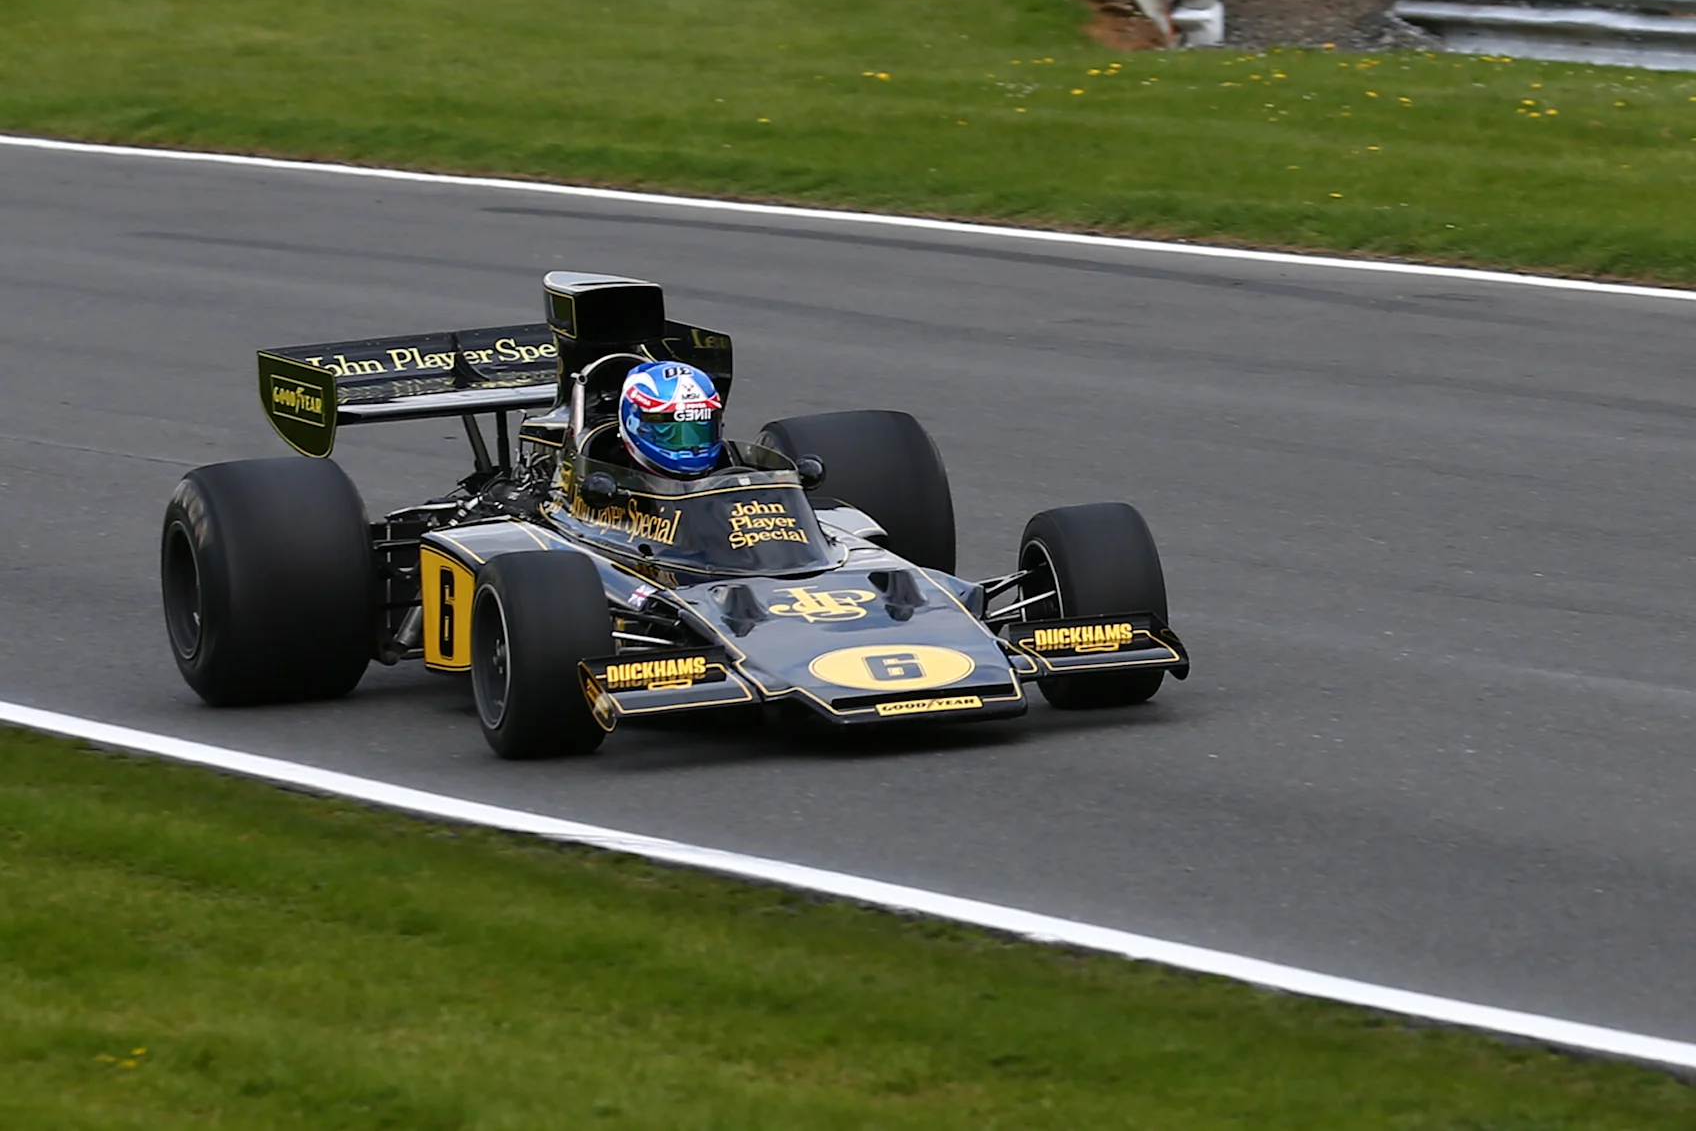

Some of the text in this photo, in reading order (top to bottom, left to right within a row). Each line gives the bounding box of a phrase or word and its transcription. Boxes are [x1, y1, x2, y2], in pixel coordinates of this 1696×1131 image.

[387, 346, 492, 372] Player
[673, 408, 712, 422] GENII
[731, 500, 787, 517] John
[627, 498, 682, 545] Special
[728, 516, 796, 532] Player
[728, 528, 810, 550] Special
[440, 567, 455, 659] 6
[1033, 622, 1134, 647] DUCKHAMS
[606, 656, 707, 683] DUCKHAMS
[863, 652, 926, 682] 6
